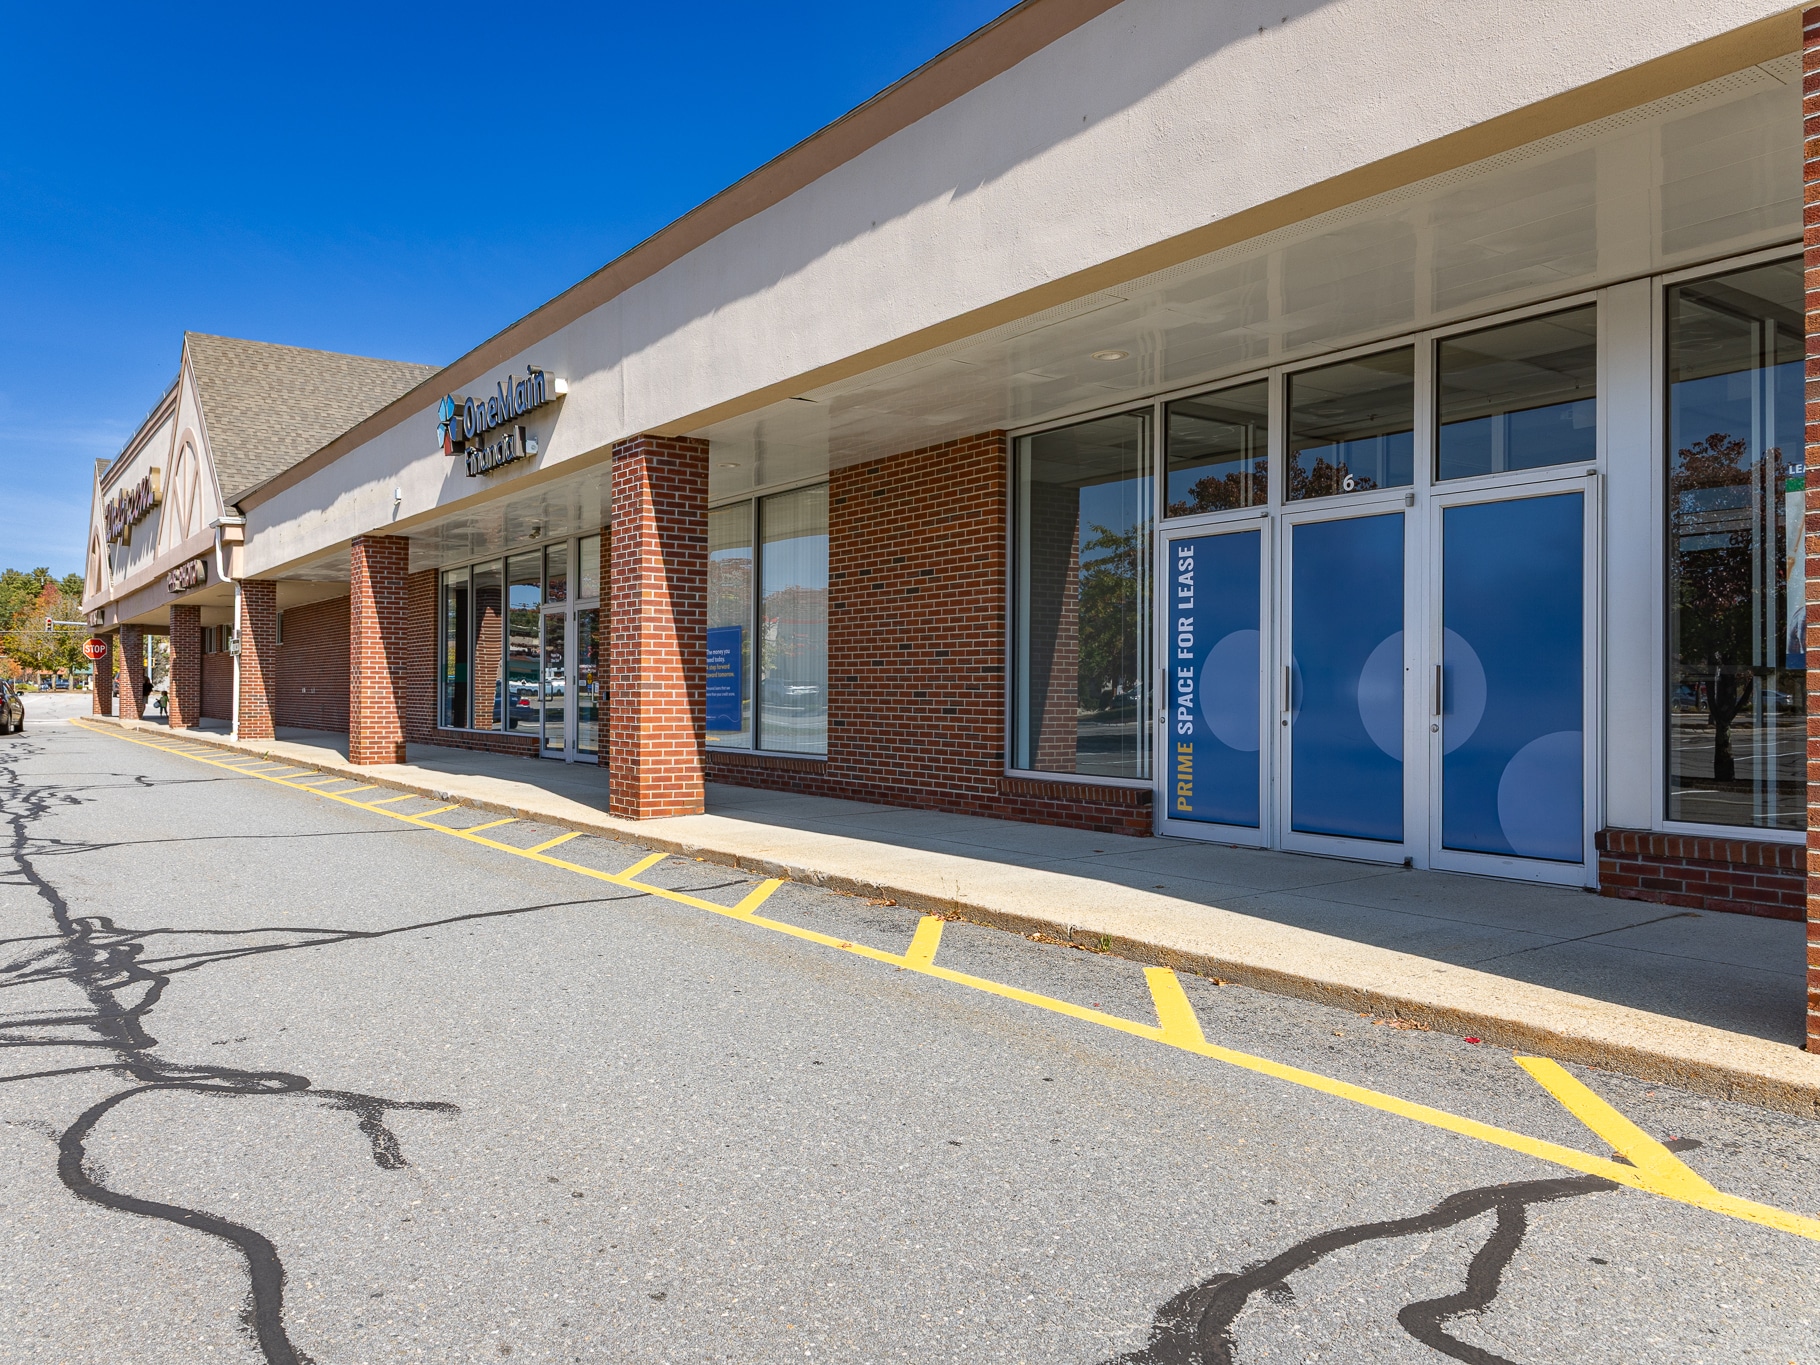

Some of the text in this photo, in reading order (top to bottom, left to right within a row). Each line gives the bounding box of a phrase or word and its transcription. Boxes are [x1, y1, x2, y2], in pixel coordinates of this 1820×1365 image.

[463, 364, 549, 438] OneMain
[464, 425, 522, 477] Financial
[1343, 473, 1355, 491] 6
[85, 645, 106, 654] STOP
[1177, 545, 1194, 812] PRIME SPACE FOR LEASE
